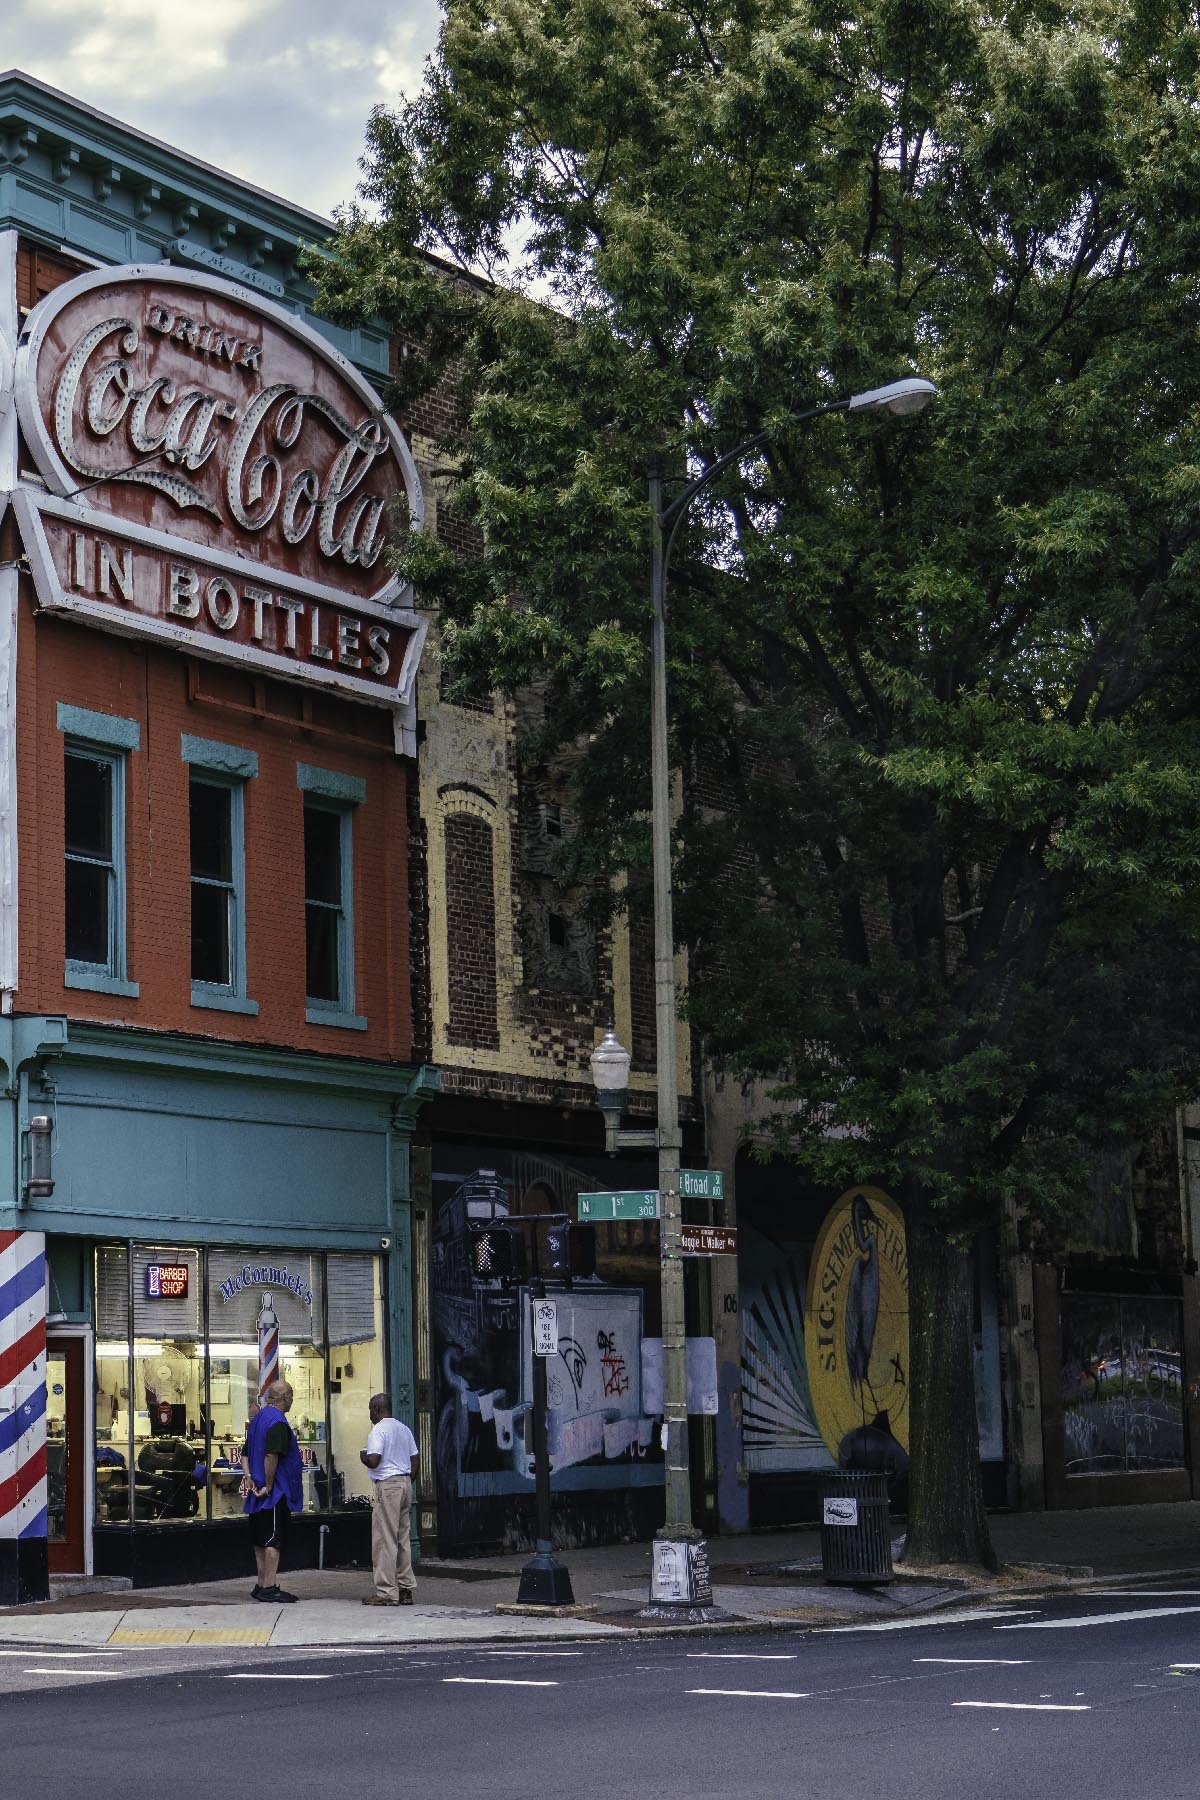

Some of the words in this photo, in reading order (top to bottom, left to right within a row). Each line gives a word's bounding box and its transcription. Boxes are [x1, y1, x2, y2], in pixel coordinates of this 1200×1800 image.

[144, 304, 263, 371] DRINK
[56, 317, 390, 569] Coca-Cola
[70, 532, 134, 600] IN
[167, 563, 390, 676] BOTTLES
[685, 1174, 708, 1194] Broad
[582, 1200, 590, 1213] N
[612, 1196, 625, 1217] 1st
[644, 1195, 654, 1204] St
[638, 1206, 654, 1216] 300
[707, 1236, 726, 1249] Walker
[159, 1267, 187, 1281] BARBER
[219, 1264, 313, 1305] McCormick's
[161, 1281, 185, 1295] SHOP
